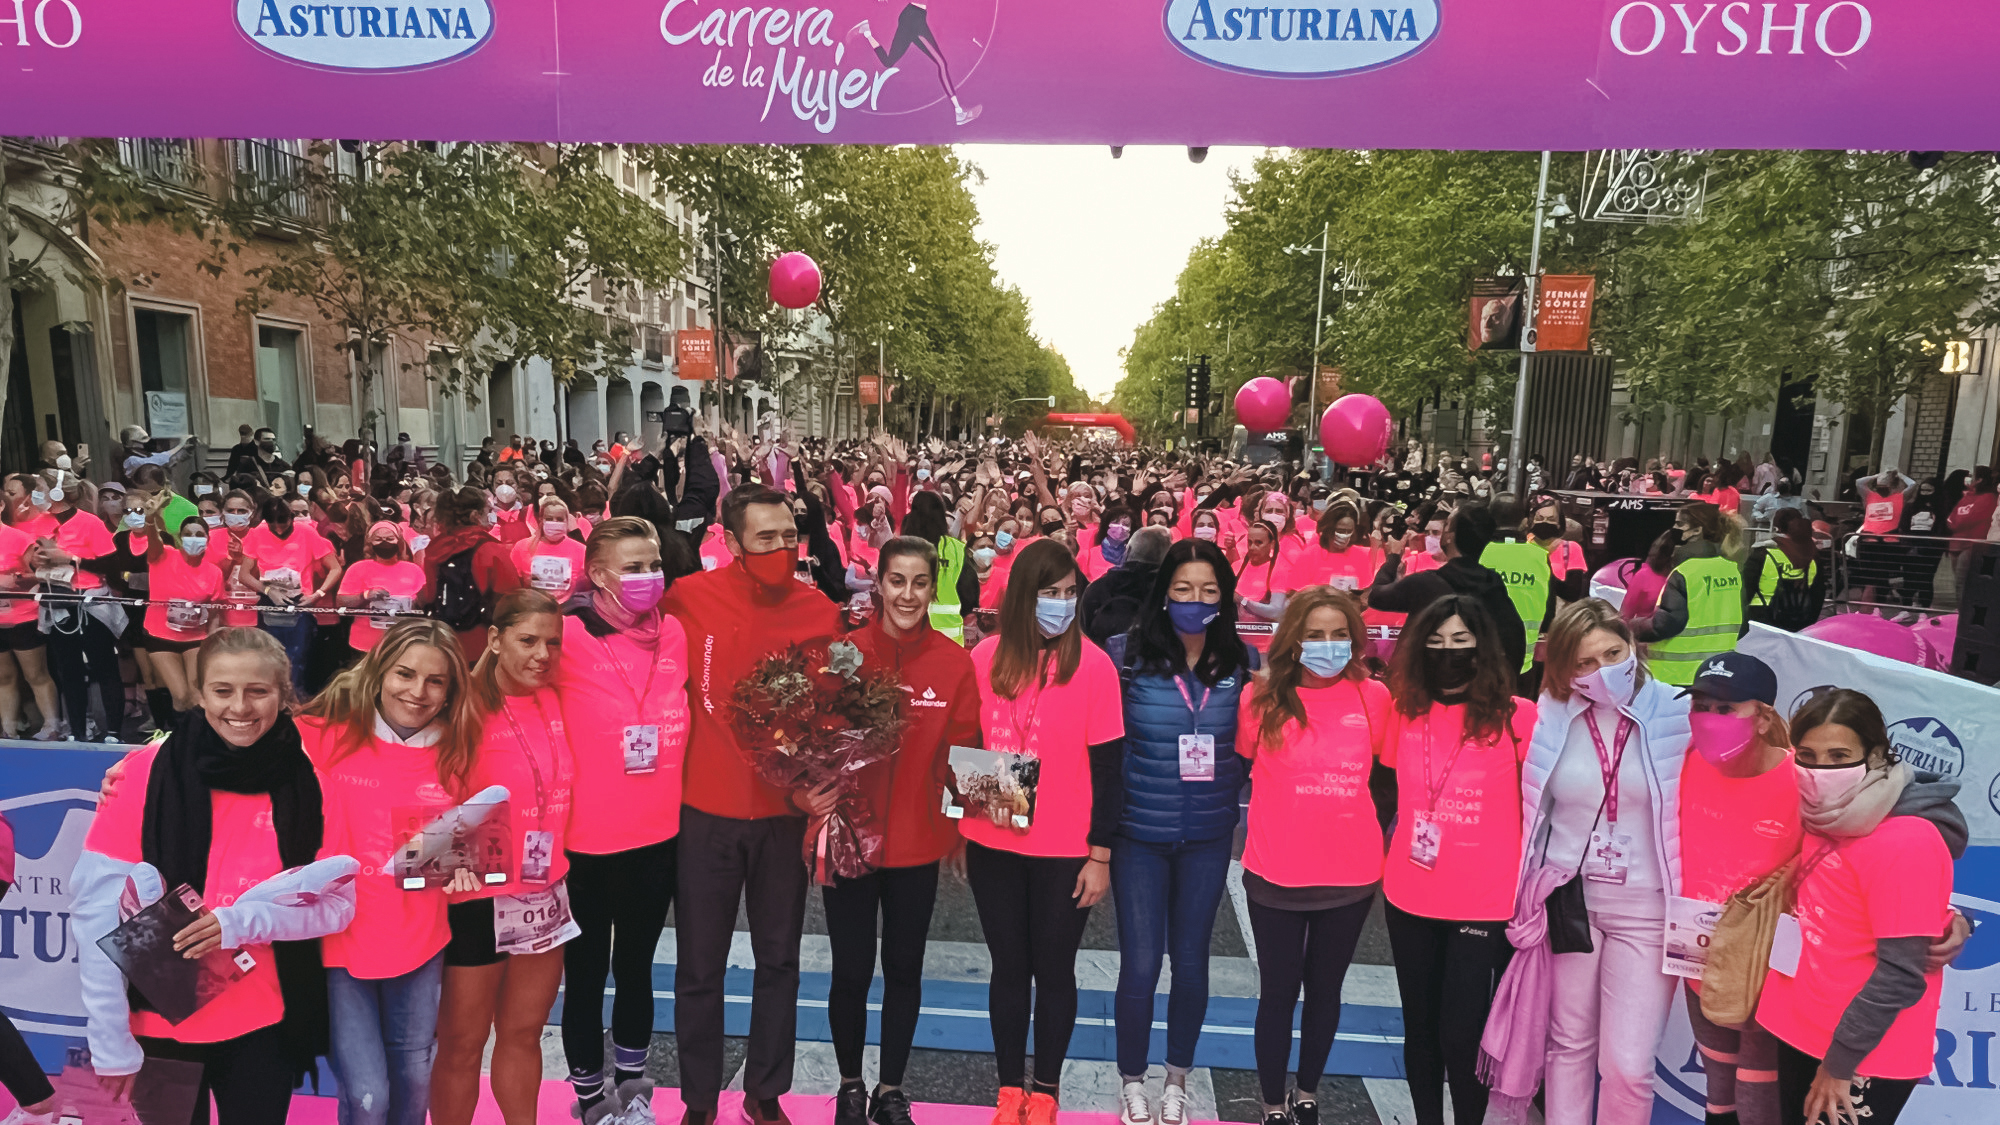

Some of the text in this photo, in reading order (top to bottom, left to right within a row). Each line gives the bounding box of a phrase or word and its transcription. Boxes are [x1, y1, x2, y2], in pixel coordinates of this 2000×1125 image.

[254, 0, 477, 39] ASTURIANA
[660, 0, 834, 47] Carrera
[1183, 0, 1420, 41] ASTURIANA
[1610, 1, 1872, 56] OYSHO
[702, 48, 765, 87] de la
[760, 43, 899, 133] Mujer
[1545, 290, 1588, 299] FERNÁN
[1545, 298, 1586, 308] GÓMEZ
[1265, 432, 1287, 440] AMS
[1620, 499, 1644, 510] AMS
[1501, 571, 1535, 586] ADM
[1713, 576, 1738, 588] ADM
[910, 698, 948, 708] Santander
[991, 727, 1011, 739] FOR
[1323, 773, 1361, 784] TODAS
[1295, 785, 1358, 797] NOSOTRAS
[1455, 787, 1483, 798] POR
[1439, 799, 1481, 811] TODAS
[1413, 809, 1480, 825] NOSOTRAS
[0, 906, 79, 963] TU
